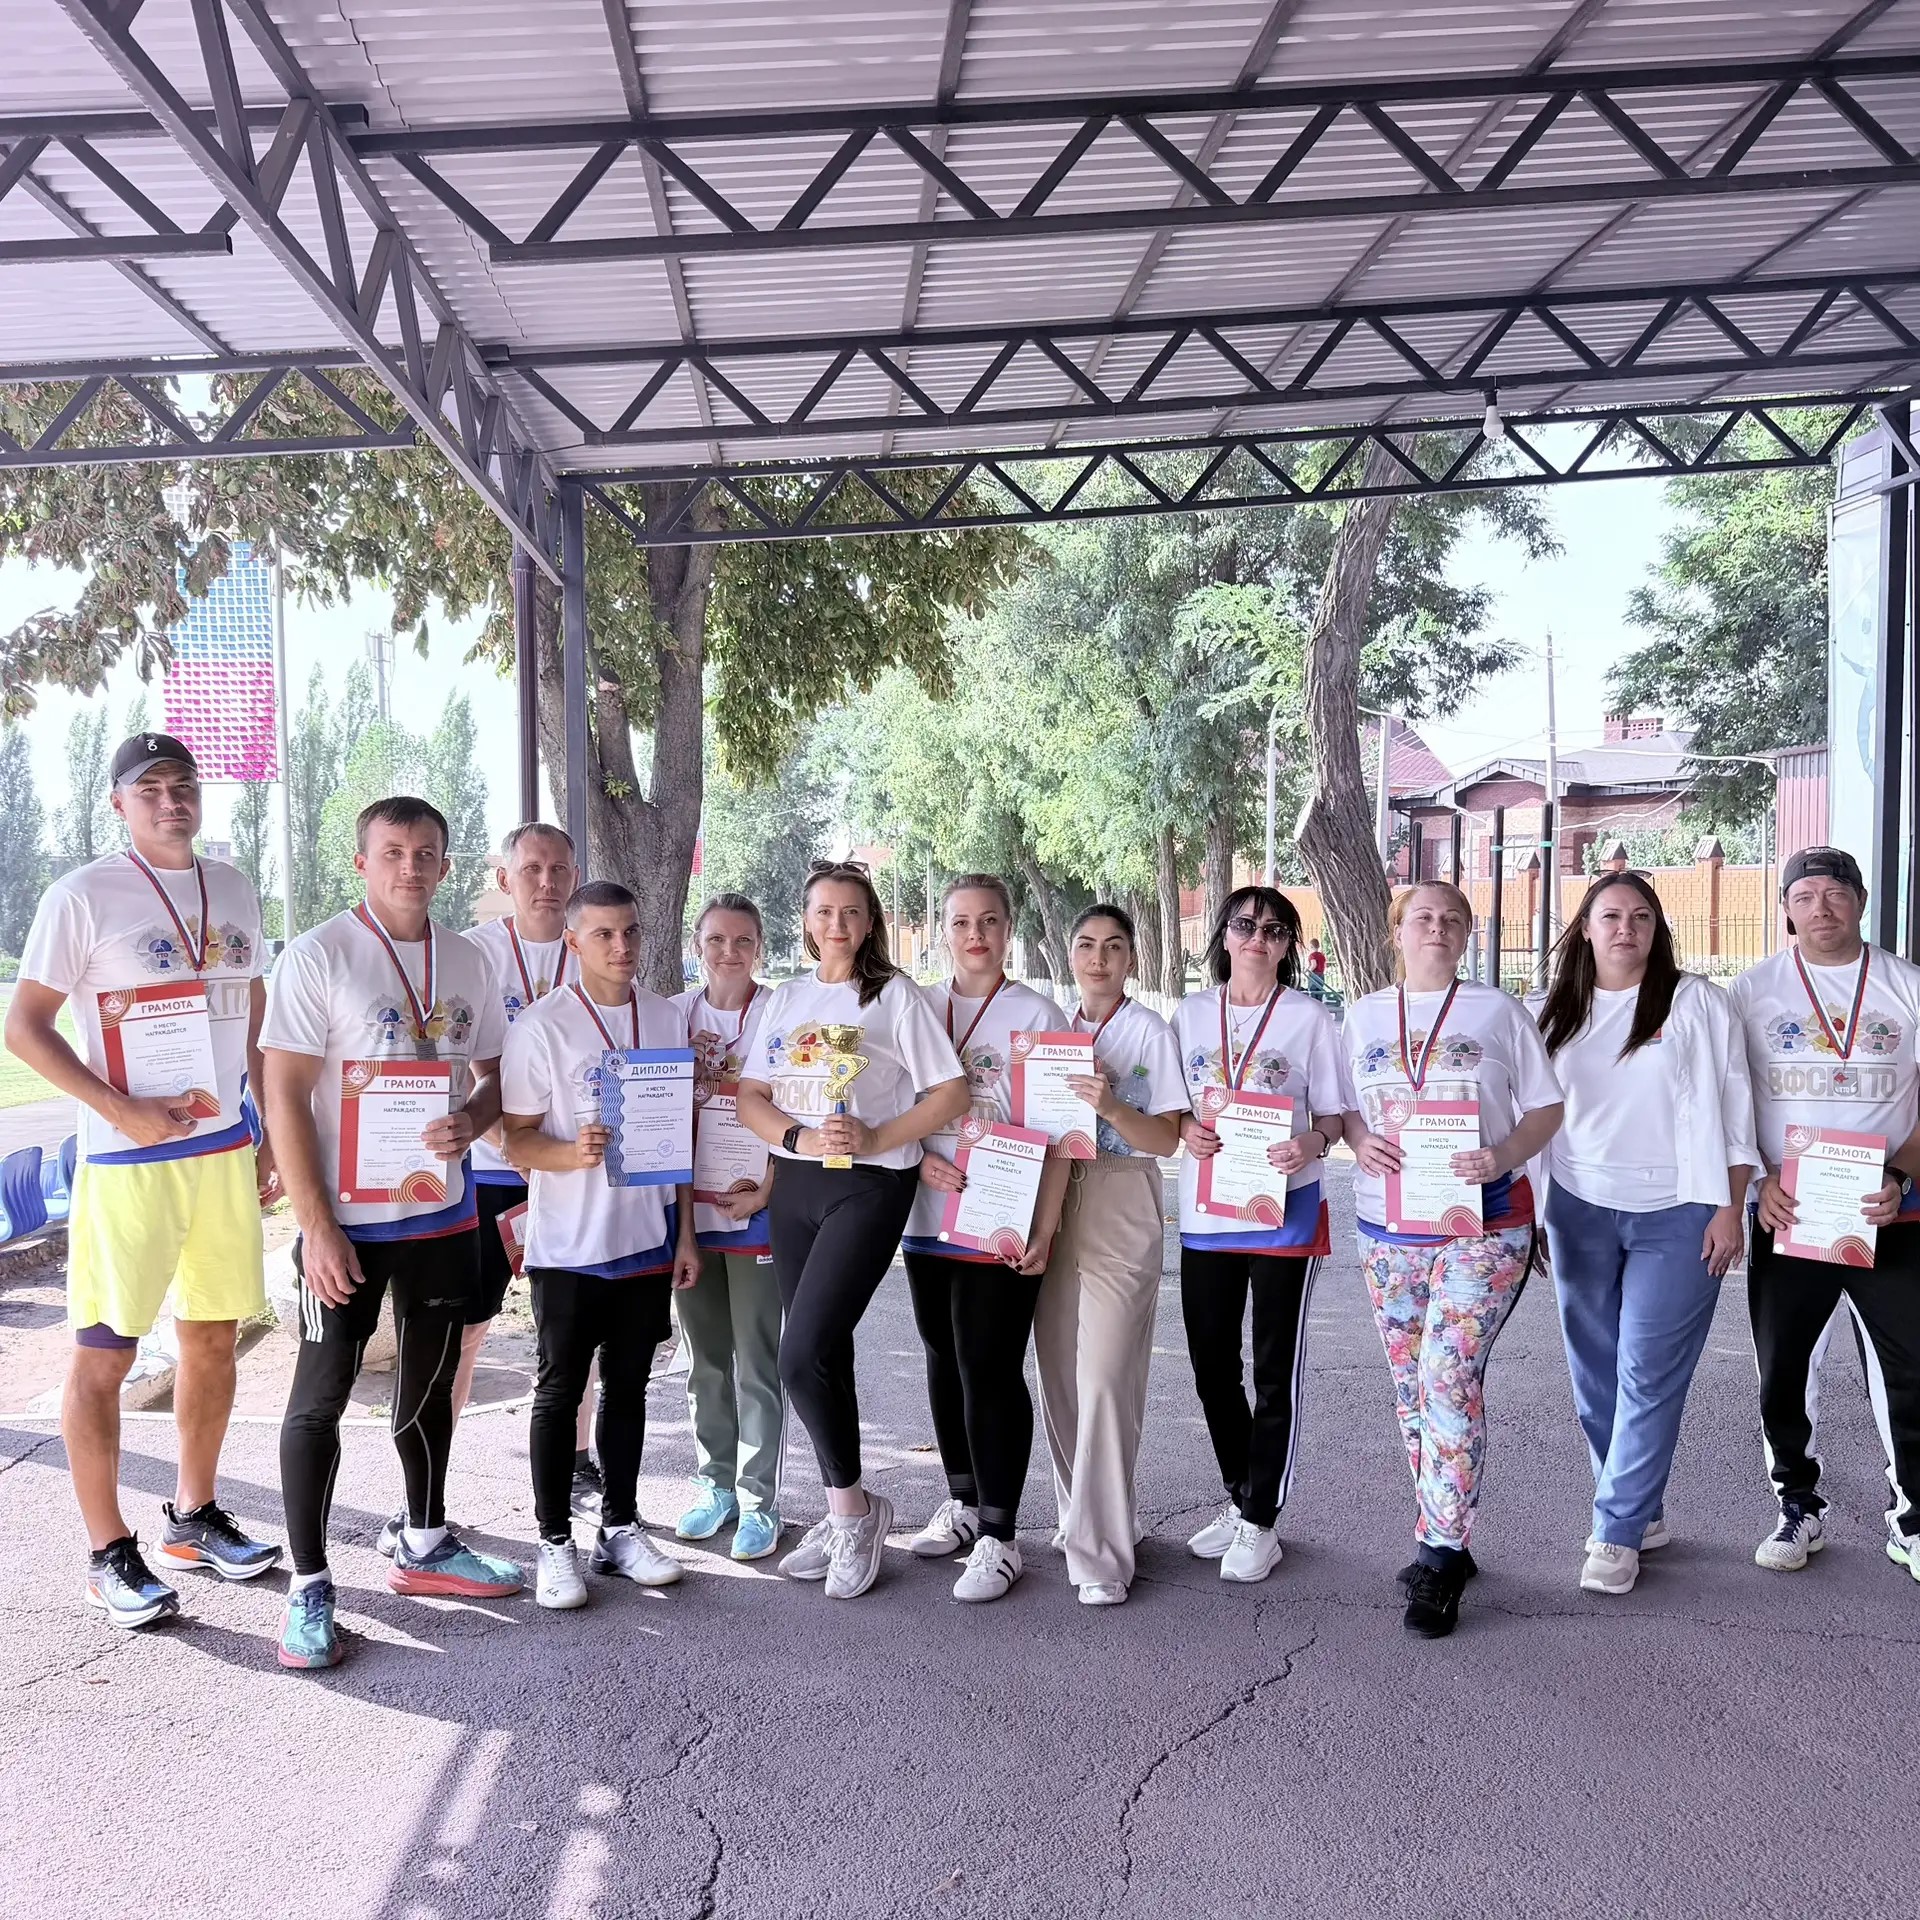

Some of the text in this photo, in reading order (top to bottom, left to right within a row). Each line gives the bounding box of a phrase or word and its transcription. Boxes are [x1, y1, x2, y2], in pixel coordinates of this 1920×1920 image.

[142, 1000, 194, 1014] ГРАМОТА
[145, 1028, 186, 1036] НАГРАЖДАЕТСЯ
[1042, 1048, 1083, 1057] ГРАМОТА
[631, 1065, 678, 1076] ДИПЛОМ
[384, 1080, 436, 1089] ГРАМОТА
[720, 1098, 736, 1107] ГРА
[1236, 1107, 1280, 1120] ГРАМОТА
[1420, 1118, 1467, 1127] ГРАМОТА
[1235, 1133, 1270, 1141] НАГРАЖДАЕТСЯ
[992, 1139, 1034, 1155] ГРАМОТА
[1822, 1146, 1871, 1159] ГРАМОТА
[988, 1164, 1022, 1174] НАГРАЖДАЕТСЯ
[1820, 1172, 1860, 1181] НАГРАЖДАЕТСЯ
